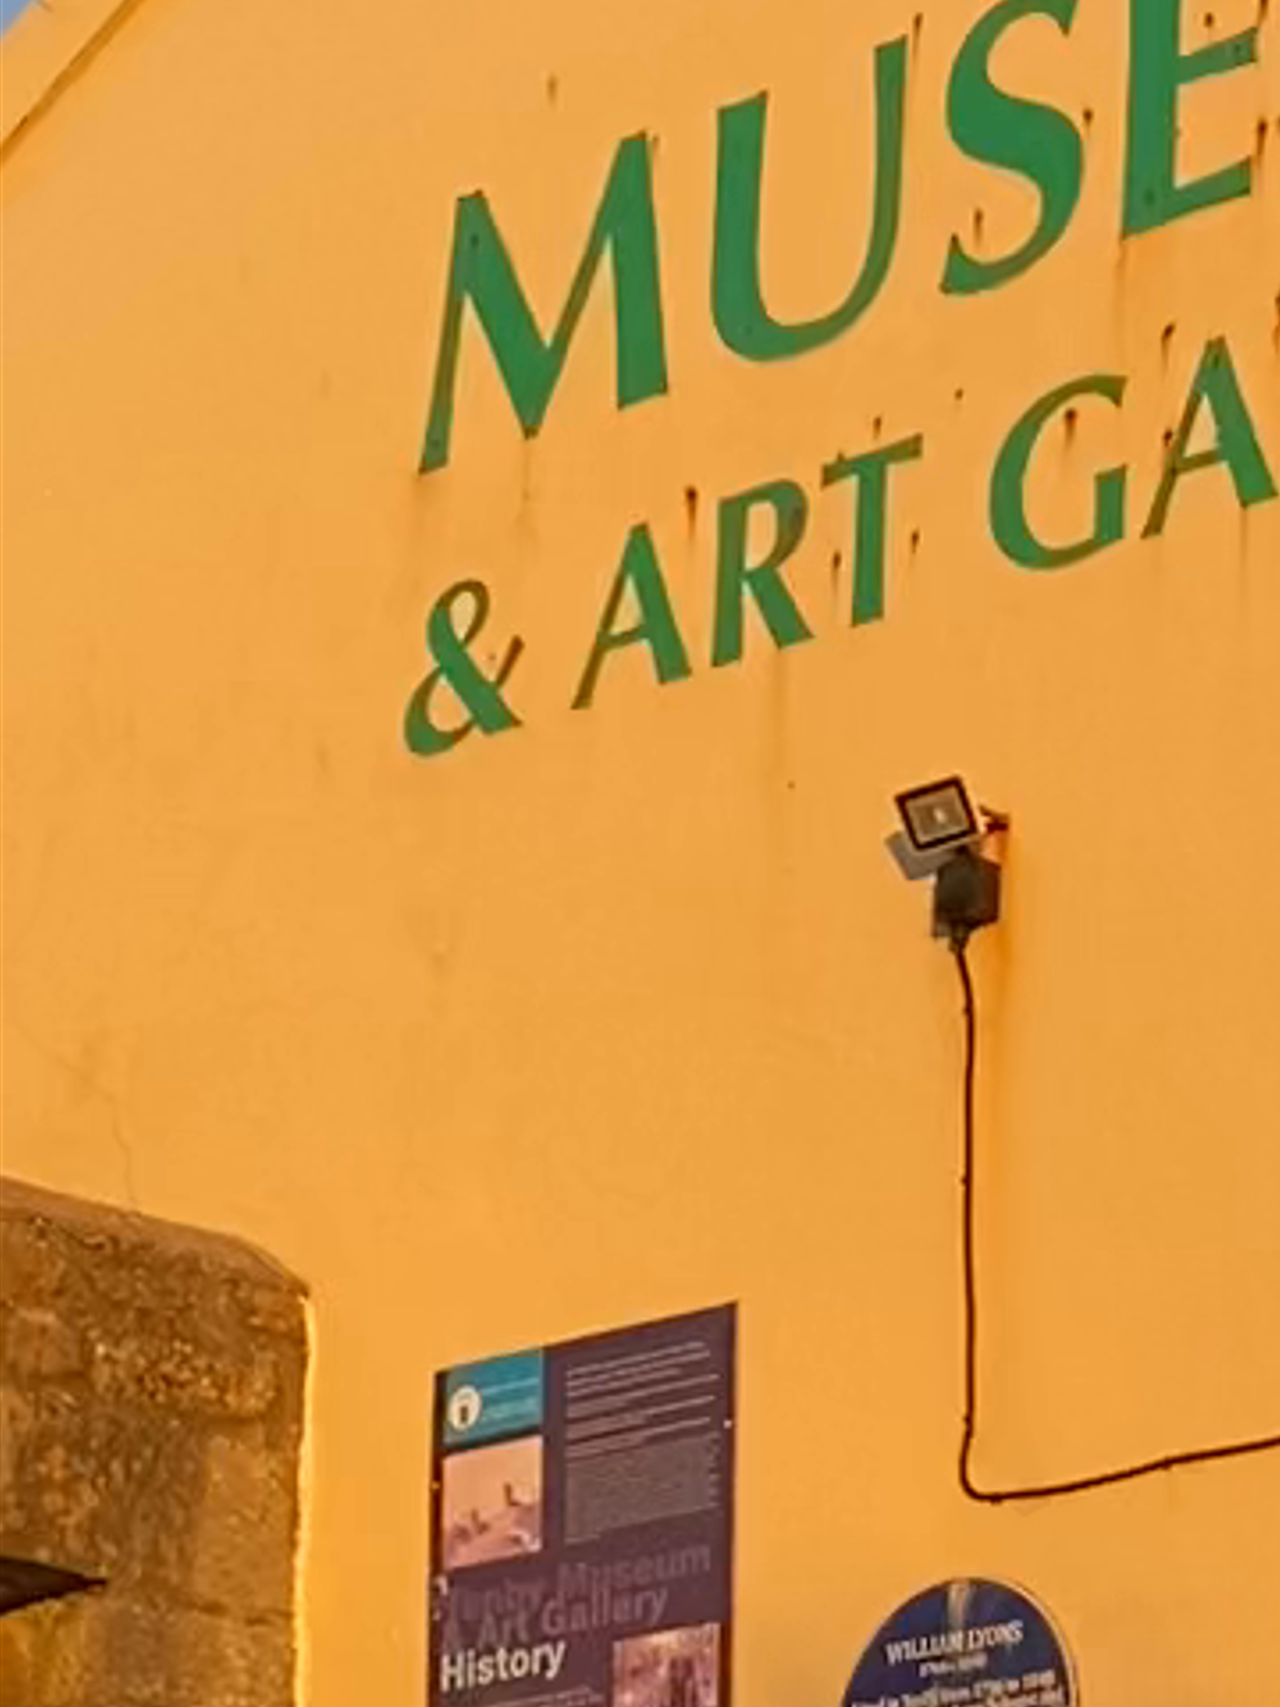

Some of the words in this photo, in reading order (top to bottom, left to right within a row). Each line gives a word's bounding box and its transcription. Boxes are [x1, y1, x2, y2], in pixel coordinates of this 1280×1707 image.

[402, 578, 525, 757] &
[571, 432, 924, 710] ART
[556, 1544, 712, 1596] Museum
[541, 1586, 668, 1635] Gallery
[440, 1641, 566, 1692] History
